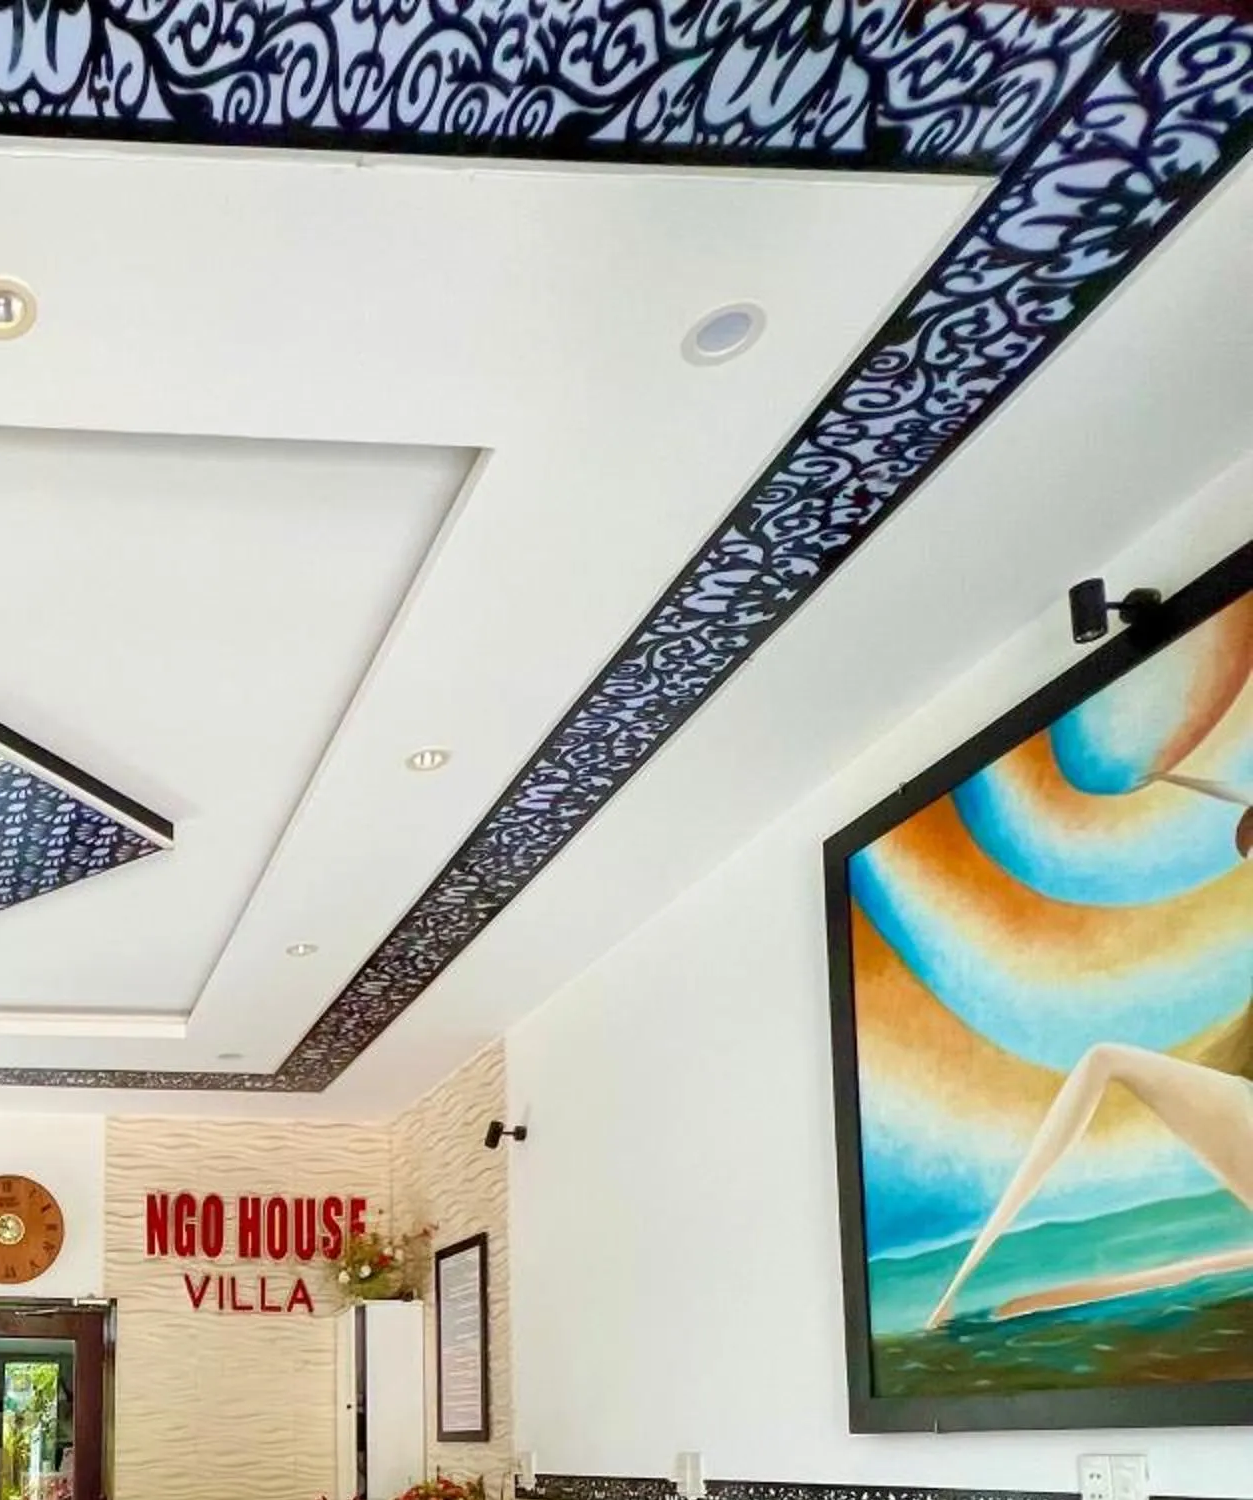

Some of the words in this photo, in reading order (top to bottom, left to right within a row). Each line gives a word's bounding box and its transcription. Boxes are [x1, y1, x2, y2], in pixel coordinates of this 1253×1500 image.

[145, 1192, 225, 1259] NGO
[238, 1196, 367, 1261] HOUSE
[184, 1274, 315, 1313] VILLA
